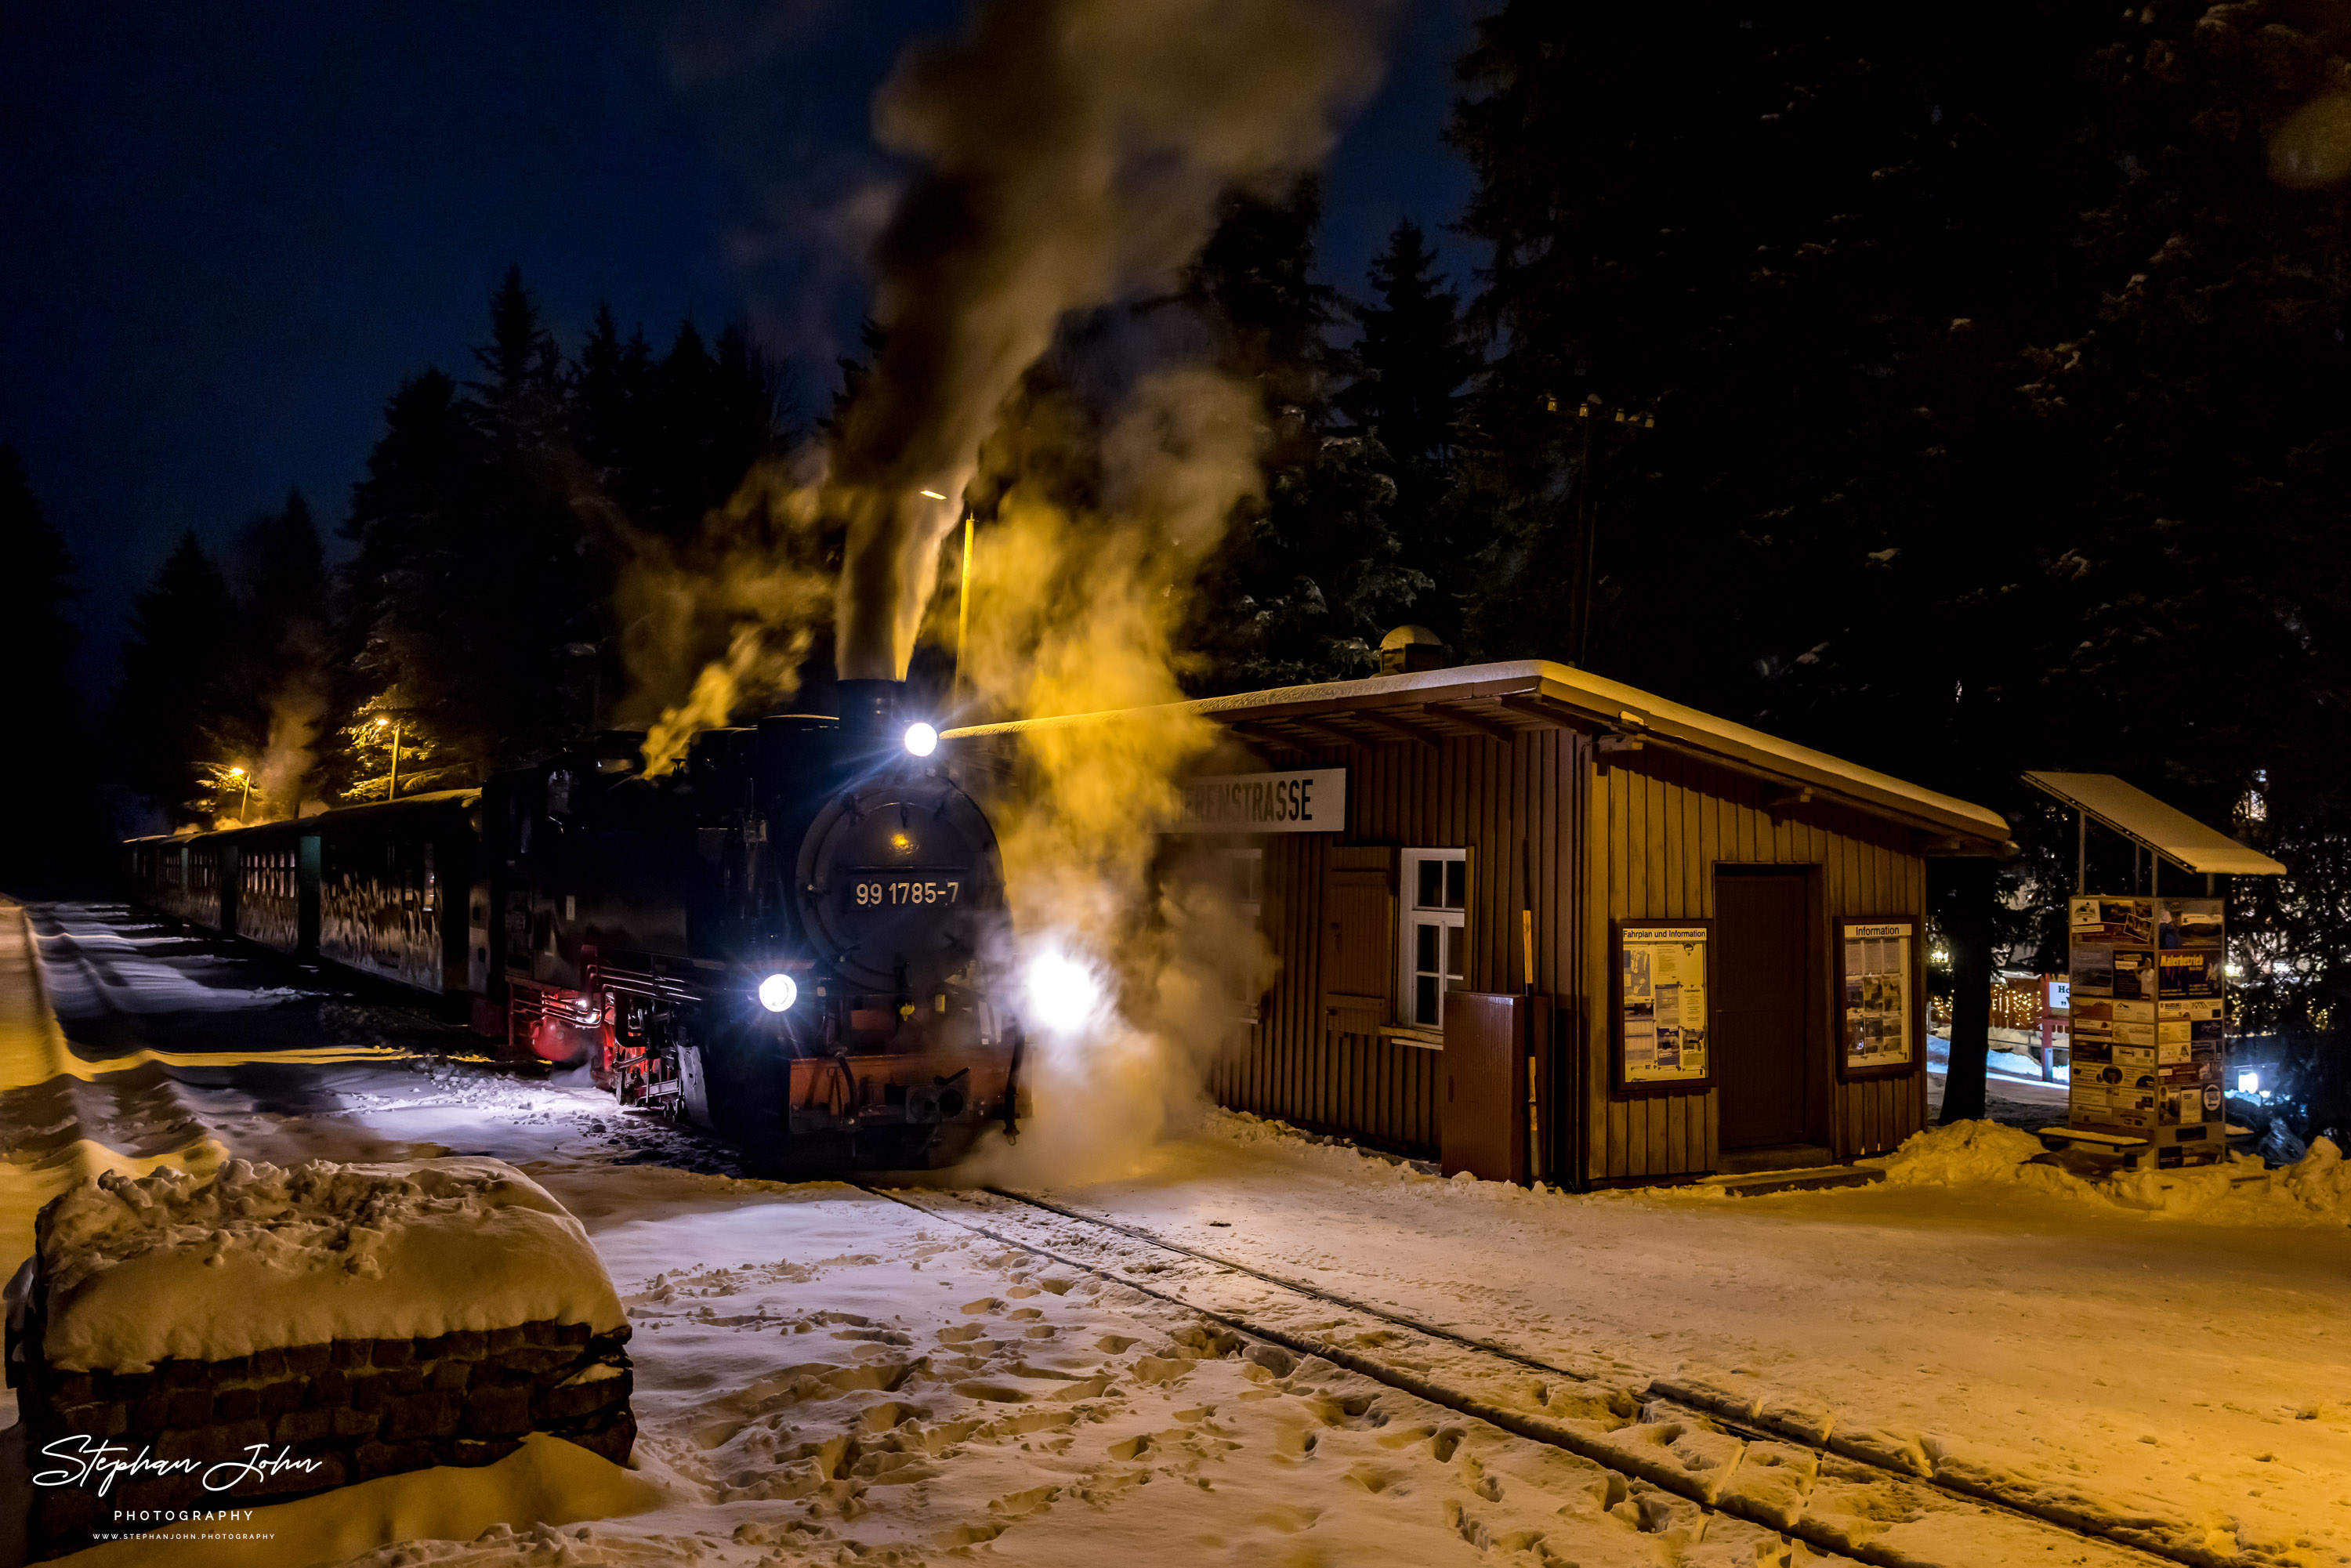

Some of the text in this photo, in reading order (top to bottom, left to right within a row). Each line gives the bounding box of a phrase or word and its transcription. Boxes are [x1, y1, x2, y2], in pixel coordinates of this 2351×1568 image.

[856, 882, 959, 905] 99 1785-7
[1623, 929, 1653, 940] Fahrplan
[1668, 929, 1706, 938] Information
[1856, 925, 1900, 936] Information
[2160, 954, 2204, 967] Malerbetrieb
[2058, 985, 2070, 994] Ho
